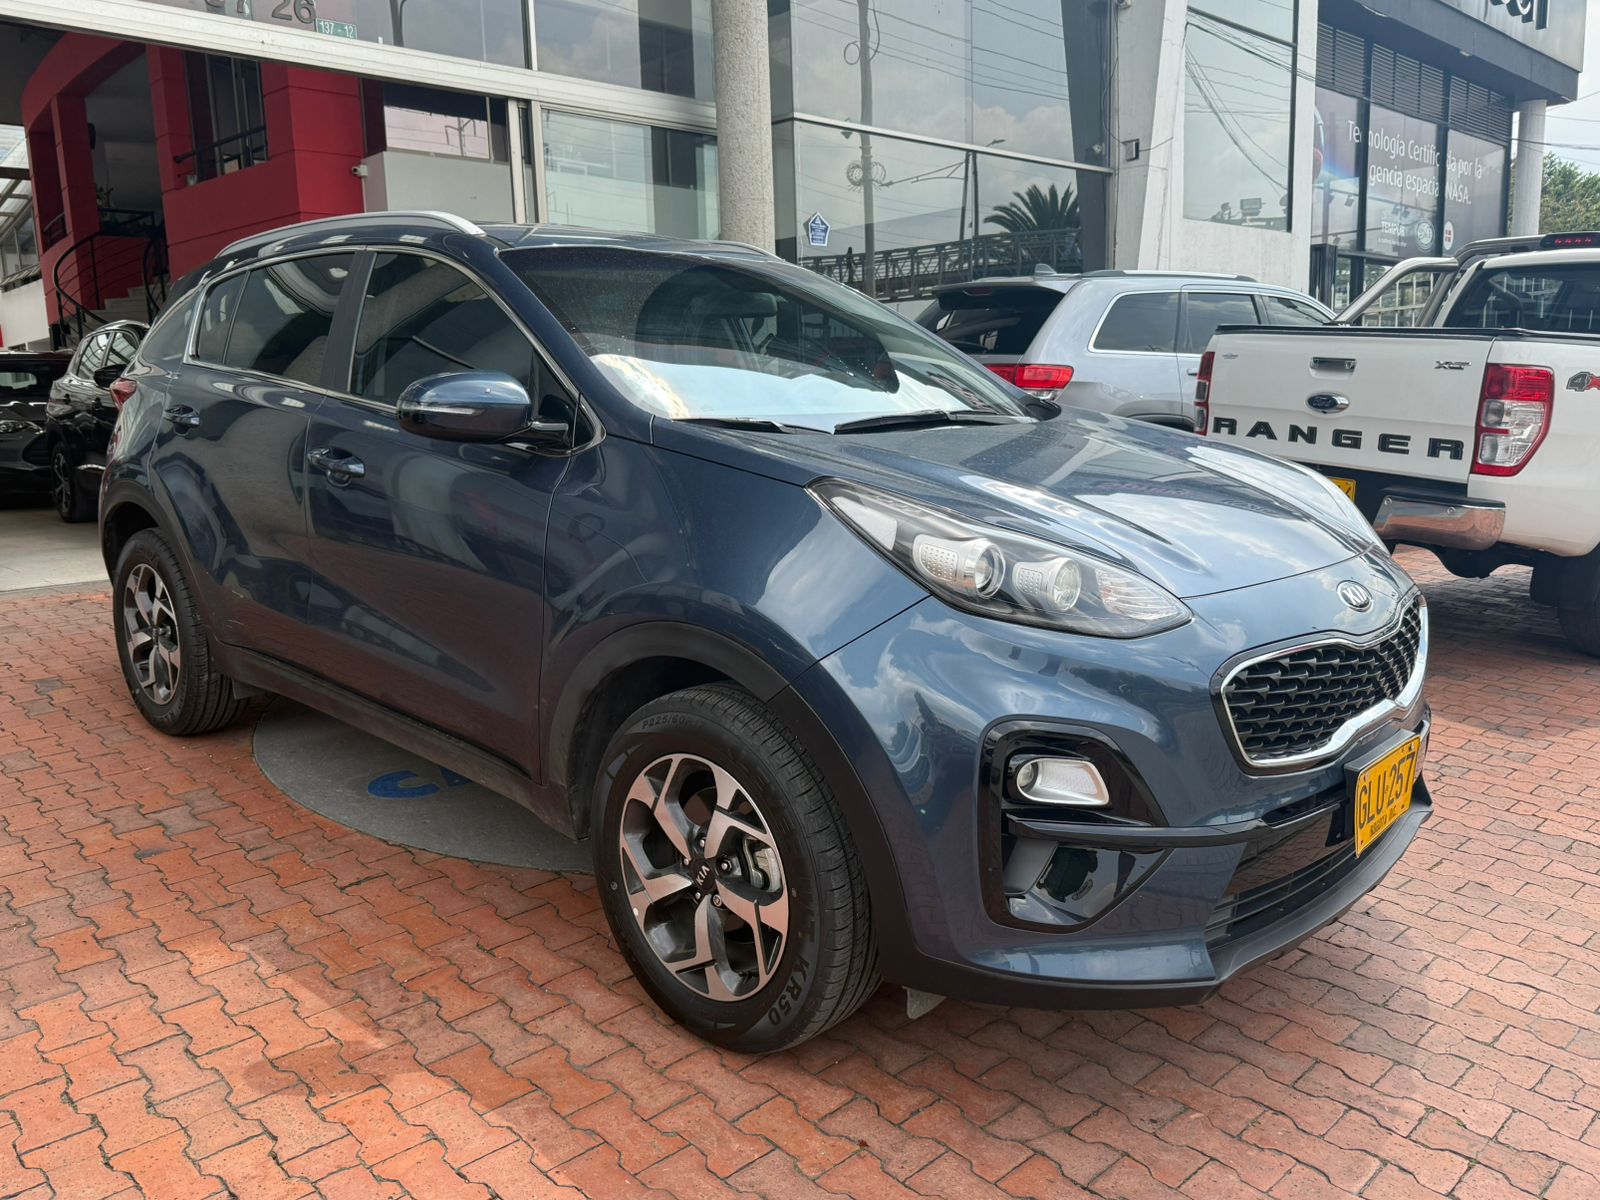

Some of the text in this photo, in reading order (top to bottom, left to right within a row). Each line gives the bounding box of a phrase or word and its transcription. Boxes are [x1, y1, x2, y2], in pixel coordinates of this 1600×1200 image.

[1408, 139, 1457, 172] Certificda
[1458, 159, 1474, 179] por
[1474, 157, 1483, 179] la
[1368, 163, 1404, 188] gencia
[1405, 173, 1440, 197] espacia
[1212, 416, 1465, 460] RANGER
[695, 864, 711, 886] KIA
